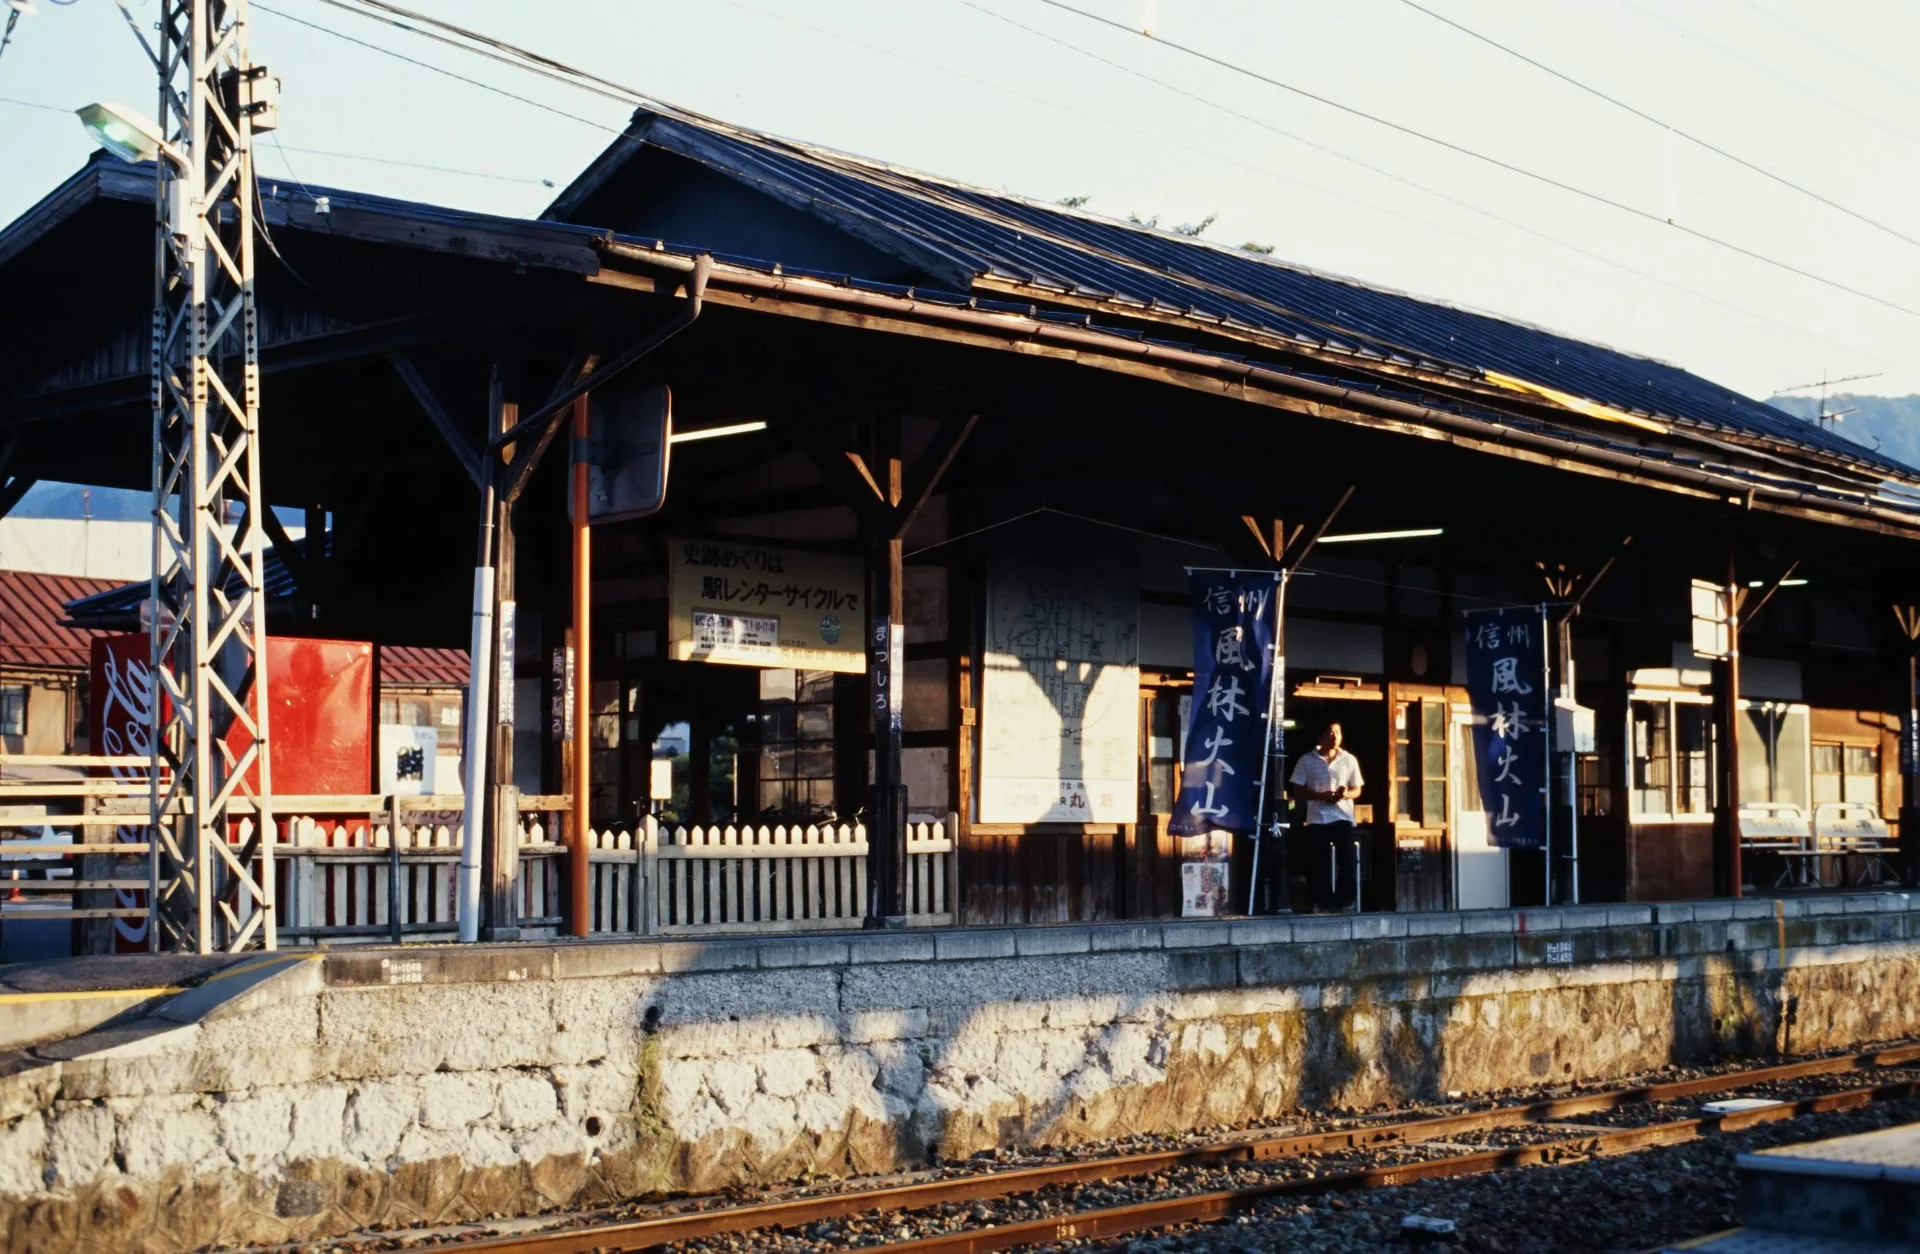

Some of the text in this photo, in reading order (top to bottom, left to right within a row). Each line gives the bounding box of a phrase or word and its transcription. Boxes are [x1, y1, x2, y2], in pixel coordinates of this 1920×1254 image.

[701, 575, 858, 611] 駅レンターサイクルで
[1204, 584, 1270, 621] 信州
[1475, 623, 1530, 650] 信州
[876, 626, 887, 709] まつしろ
[1189, 626, 1255, 818] 風林火山
[1486, 657, 1532, 827] 風林火山
